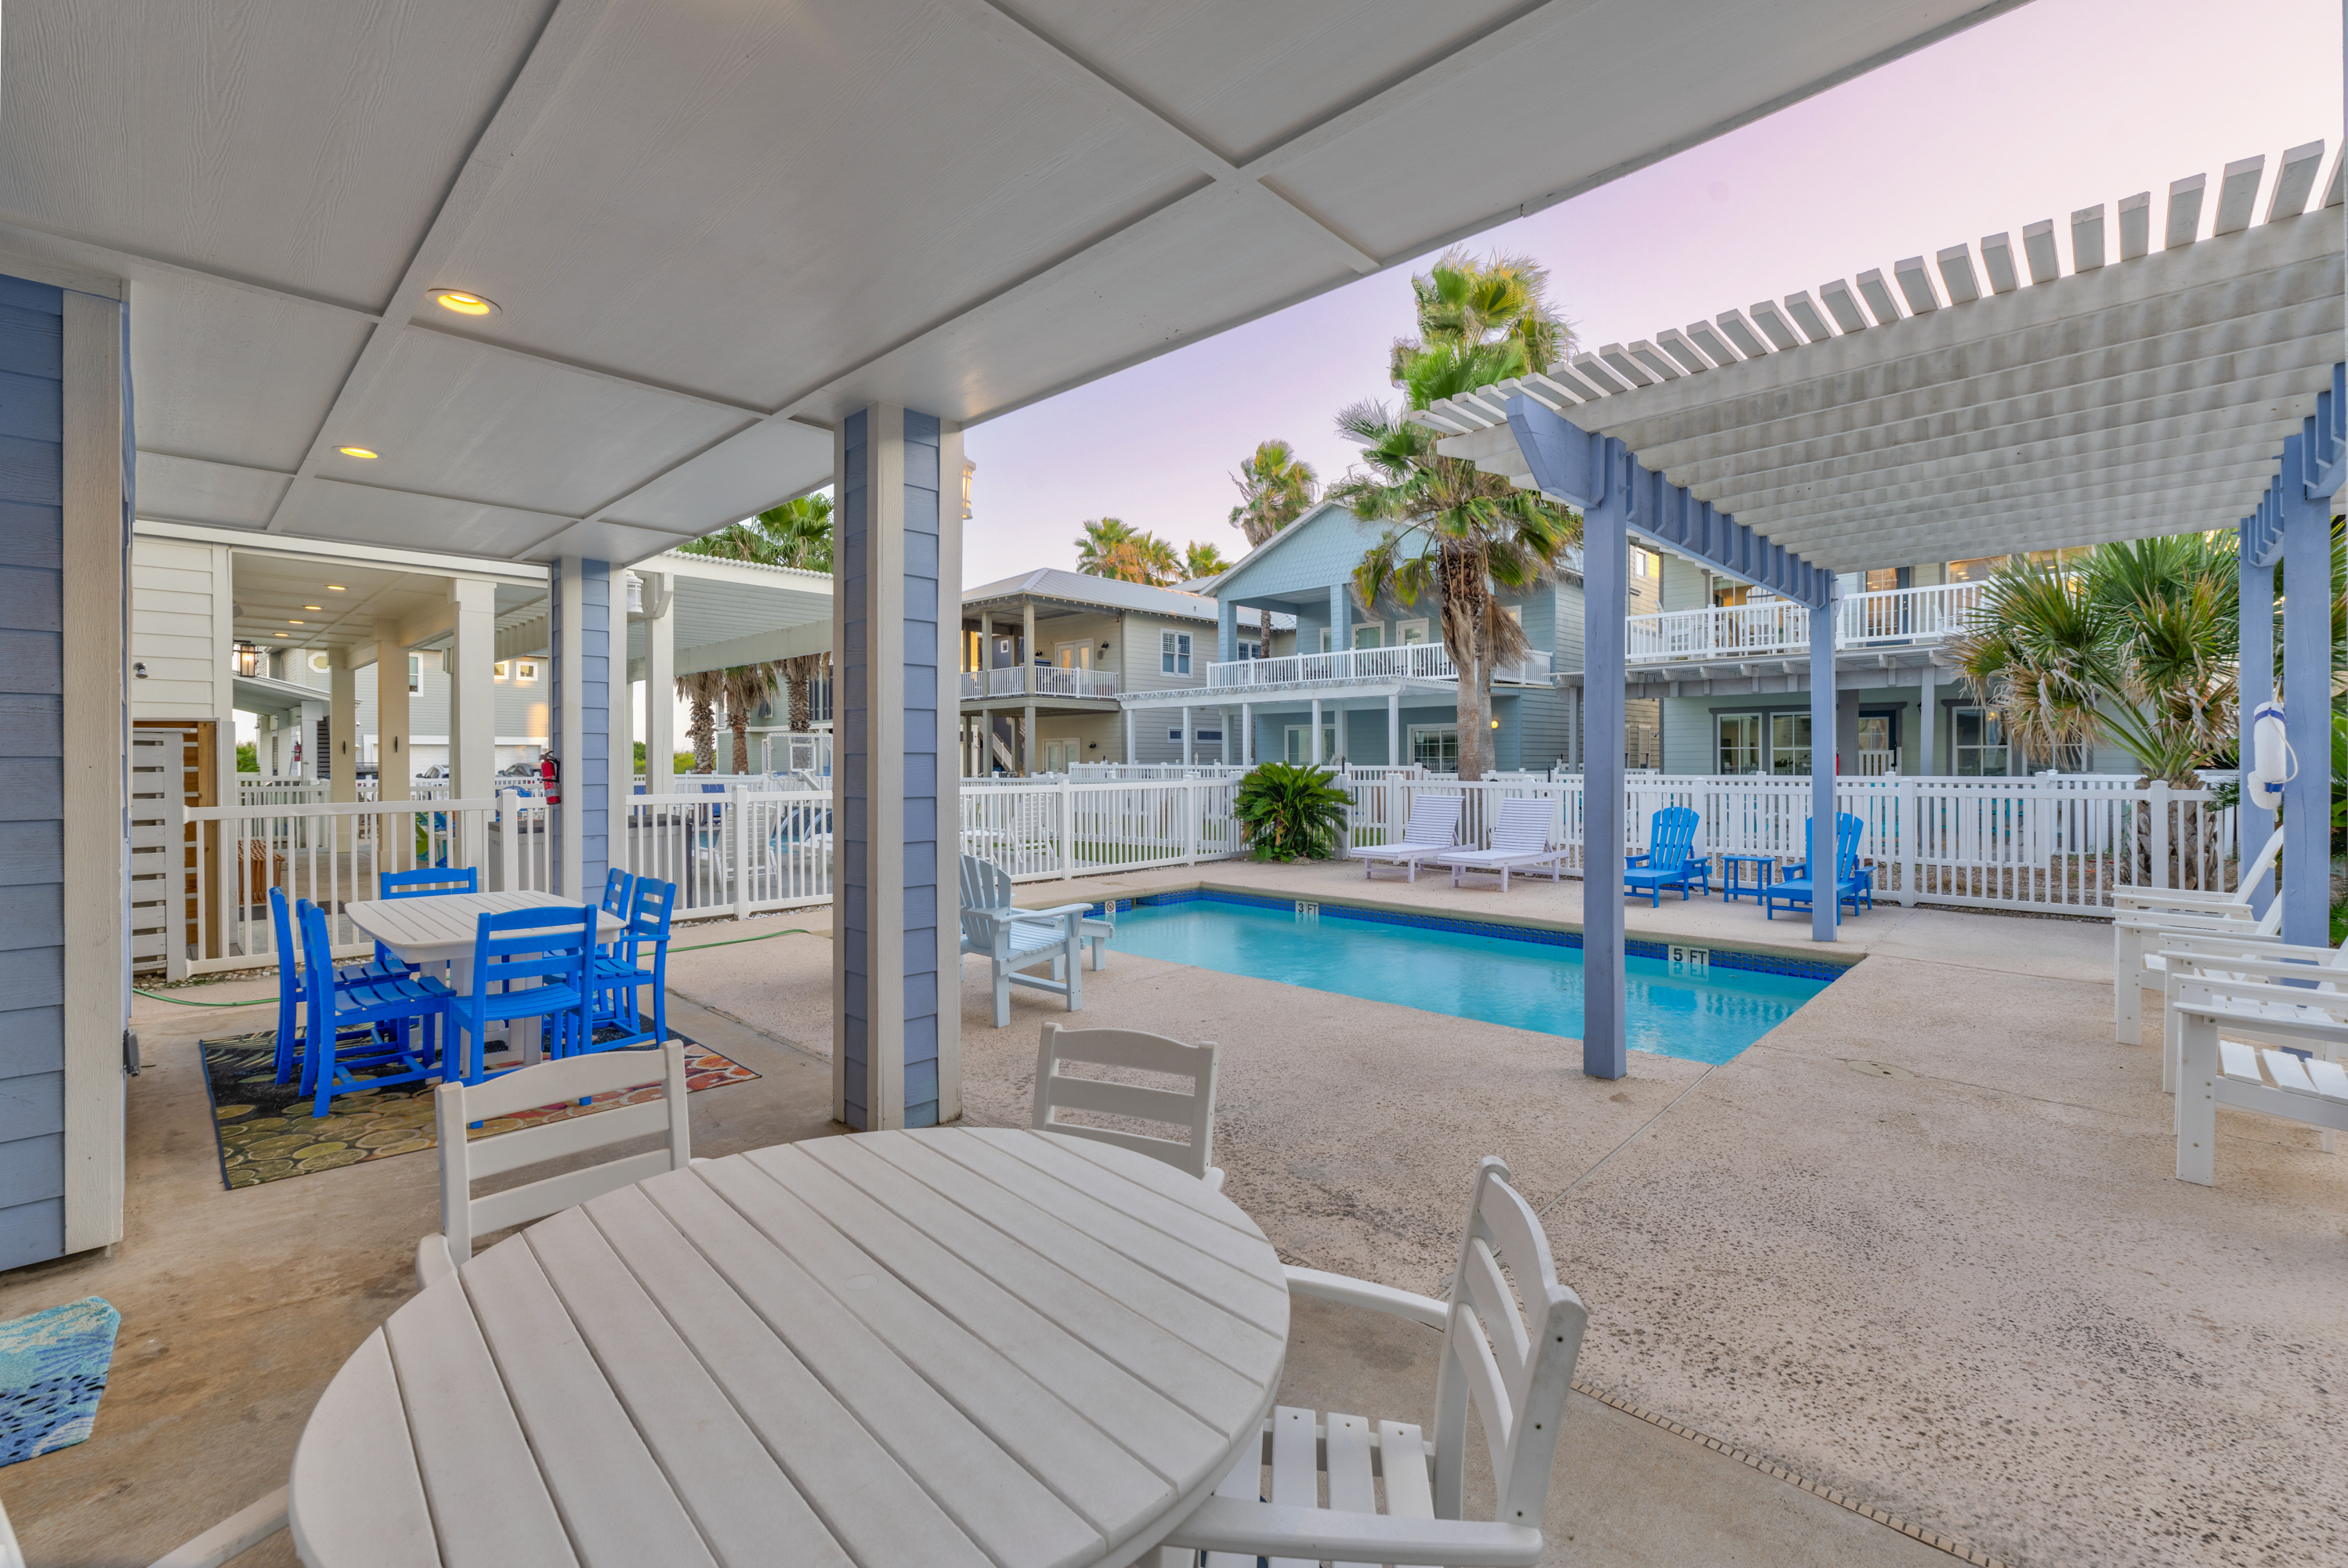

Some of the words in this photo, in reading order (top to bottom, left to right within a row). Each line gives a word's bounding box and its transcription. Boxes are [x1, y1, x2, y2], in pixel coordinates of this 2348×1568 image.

[1298, 902, 1304, 913] 3
[1308, 904, 1317, 915] FT
[1673, 948, 1683, 961] 5
[1690, 950, 1706, 965] FT
